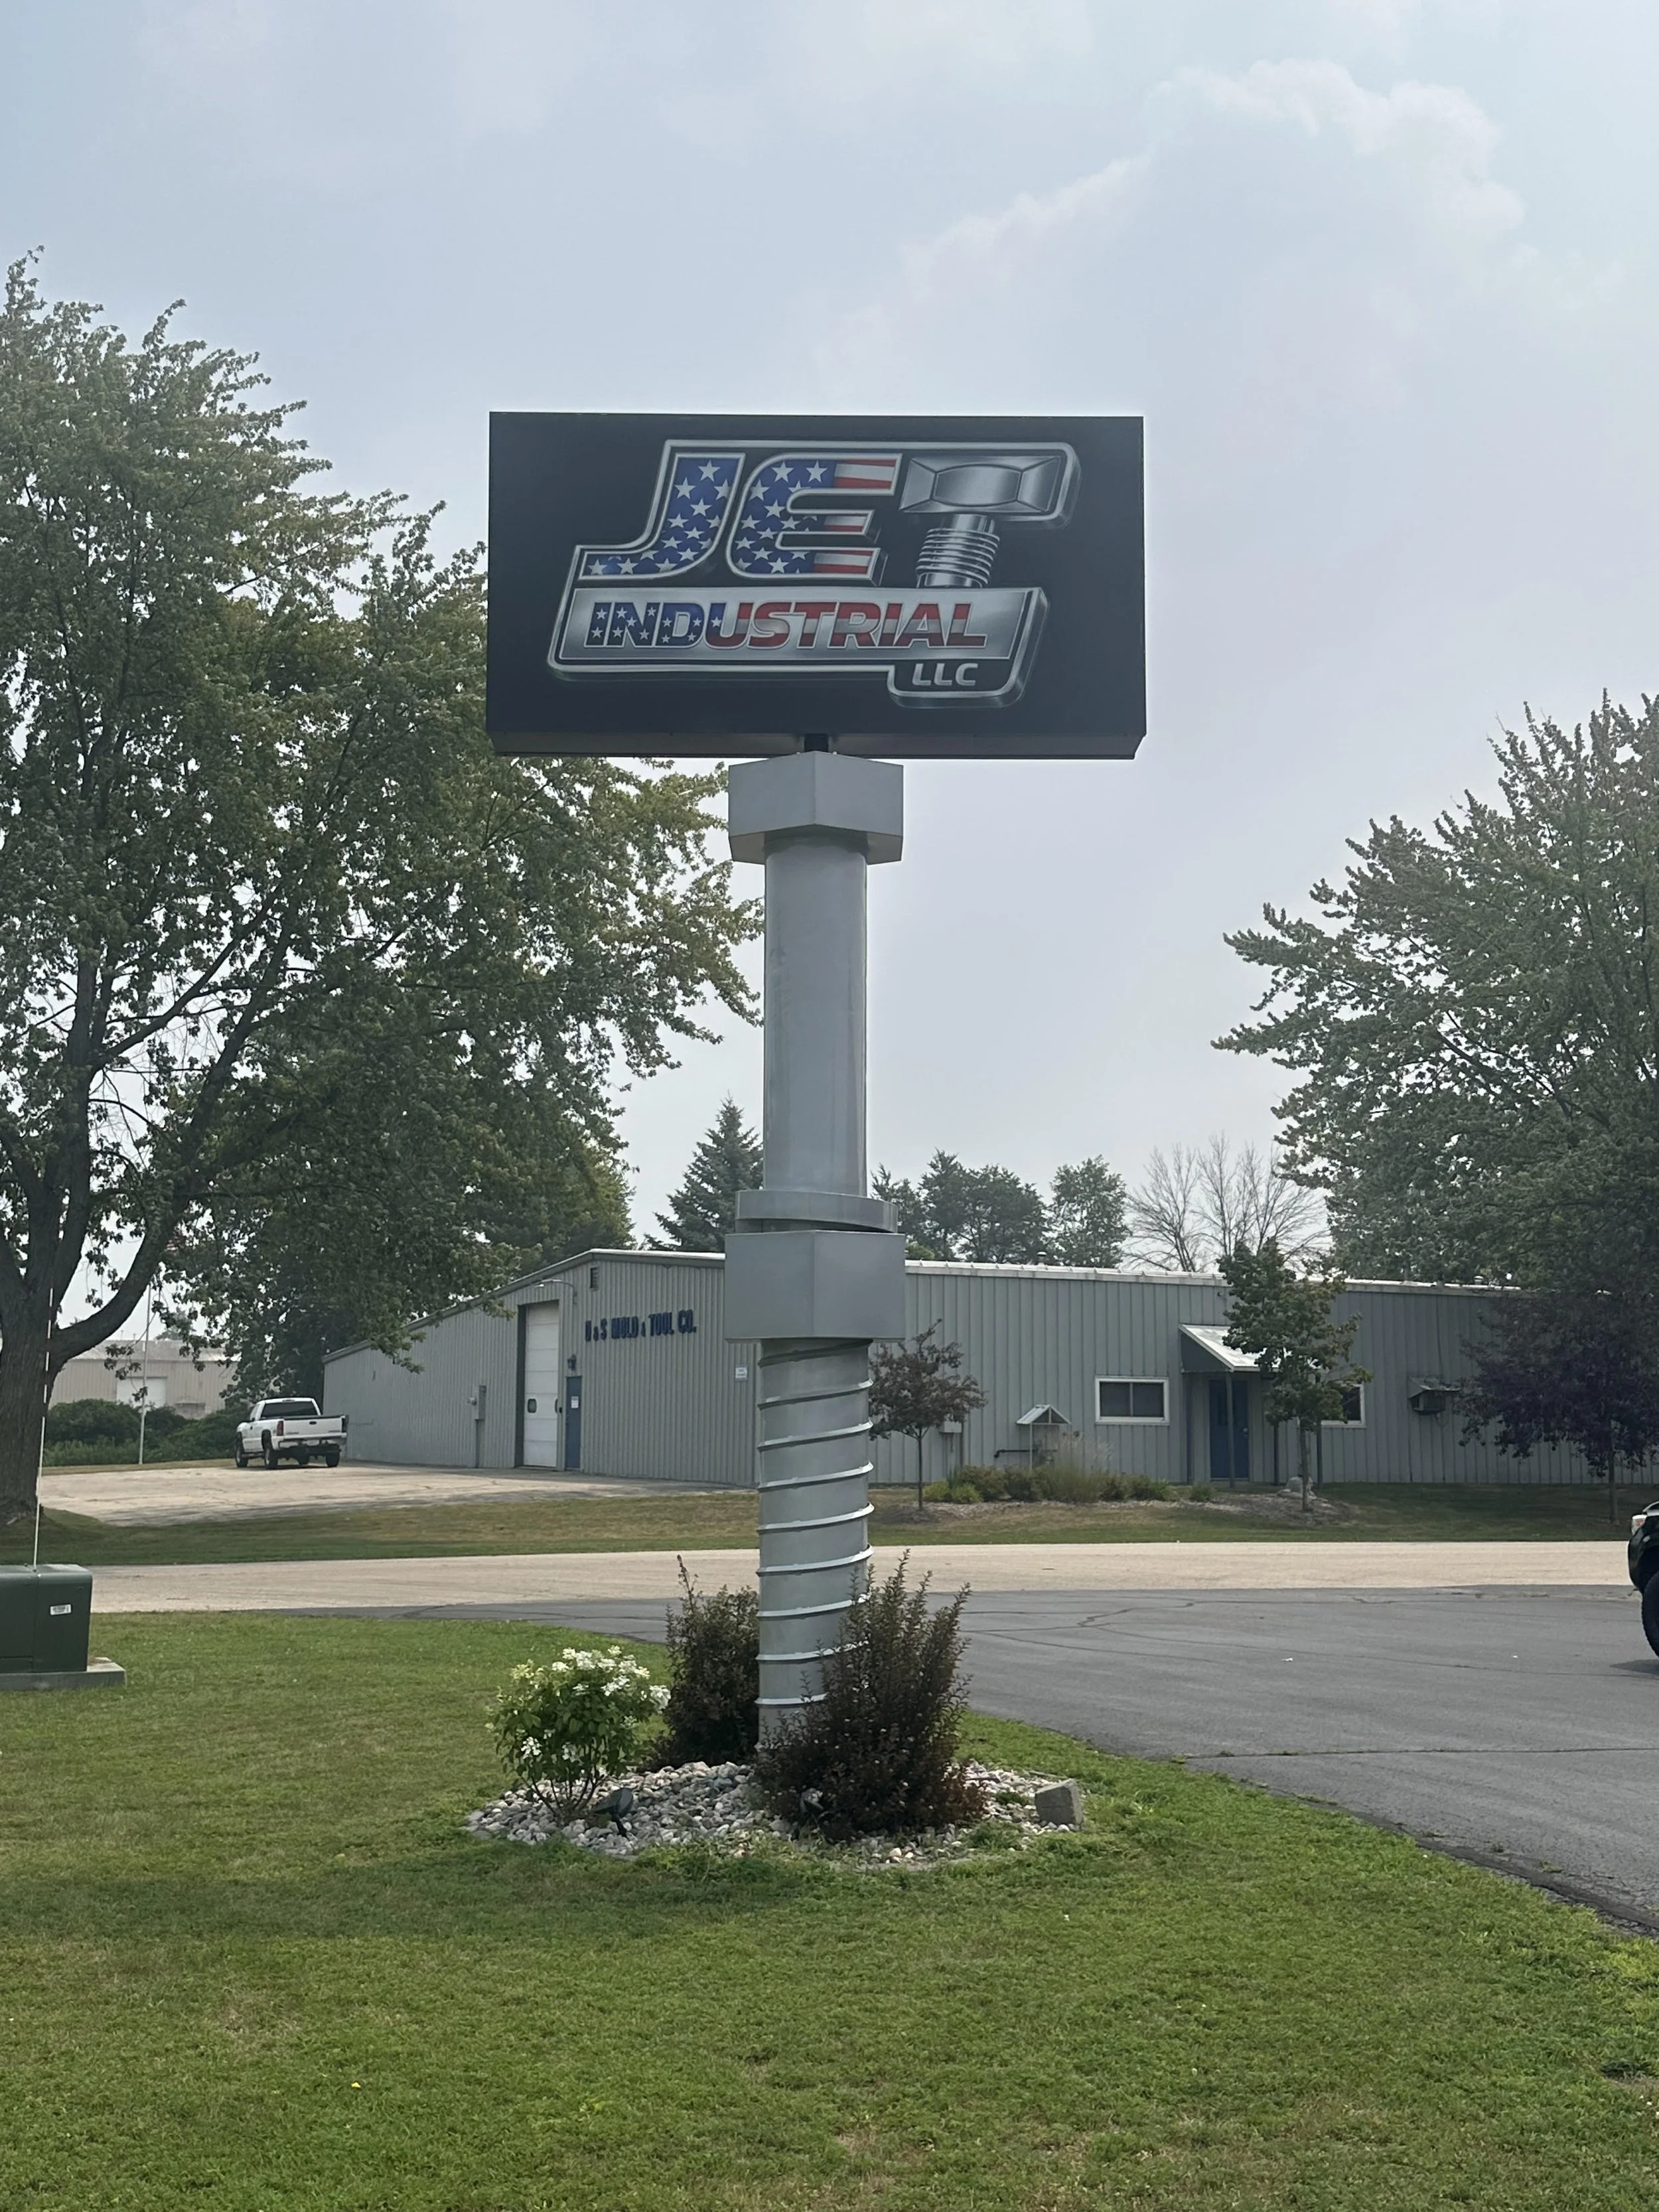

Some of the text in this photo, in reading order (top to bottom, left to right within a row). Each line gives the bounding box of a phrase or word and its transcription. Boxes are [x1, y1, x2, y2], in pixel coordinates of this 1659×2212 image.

[578, 453, 1061, 588] JET
[583, 601, 988, 648] INDUSTRIAL
[911, 662, 979, 686] LLC
[611, 1316, 639, 1339] MOLD
[648, 1311, 674, 1337] TOOL
[678, 1309, 697, 1333] CO.
